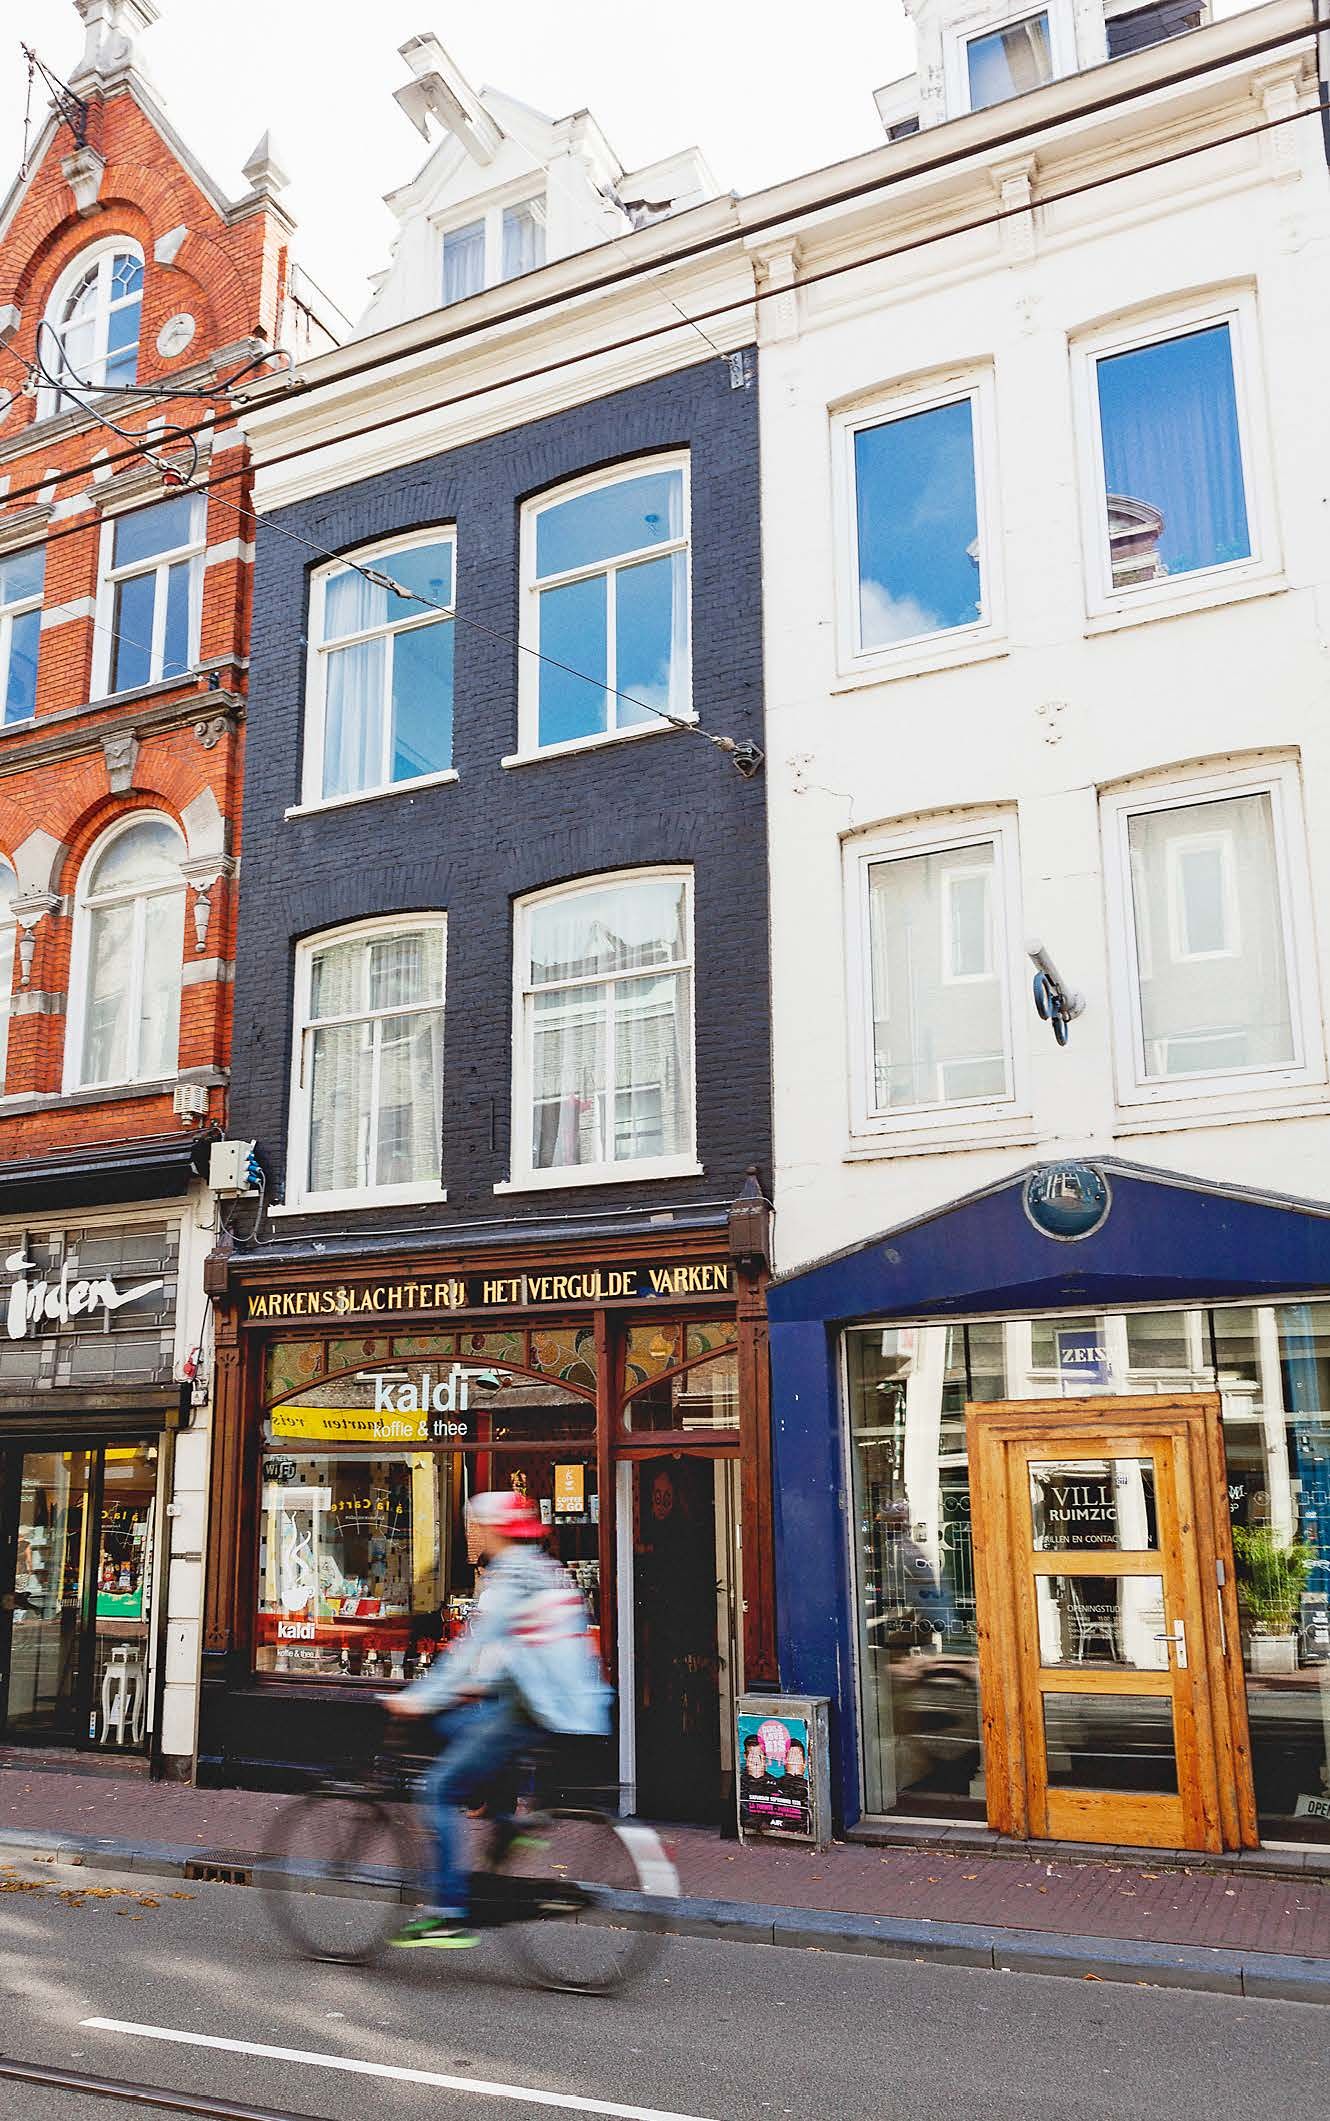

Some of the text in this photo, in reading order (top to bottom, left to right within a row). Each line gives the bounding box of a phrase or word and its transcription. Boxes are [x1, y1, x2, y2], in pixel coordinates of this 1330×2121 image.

[483, 1278, 523, 1304] HET
[527, 1271, 637, 1300] VERGULDE
[648, 1264, 728, 1293] VARKEN
[374, 1373, 469, 1413] kaldi
[373, 1420, 468, 1438] koffie & thee
[1051, 1486, 1115, 1506] VILL
[557, 1502, 583, 1511] 2 GO
[1072, 1535, 1082, 1543] EN
[277, 1621, 315, 1640] kaldi
[277, 1649, 315, 1658] koffie & thee
